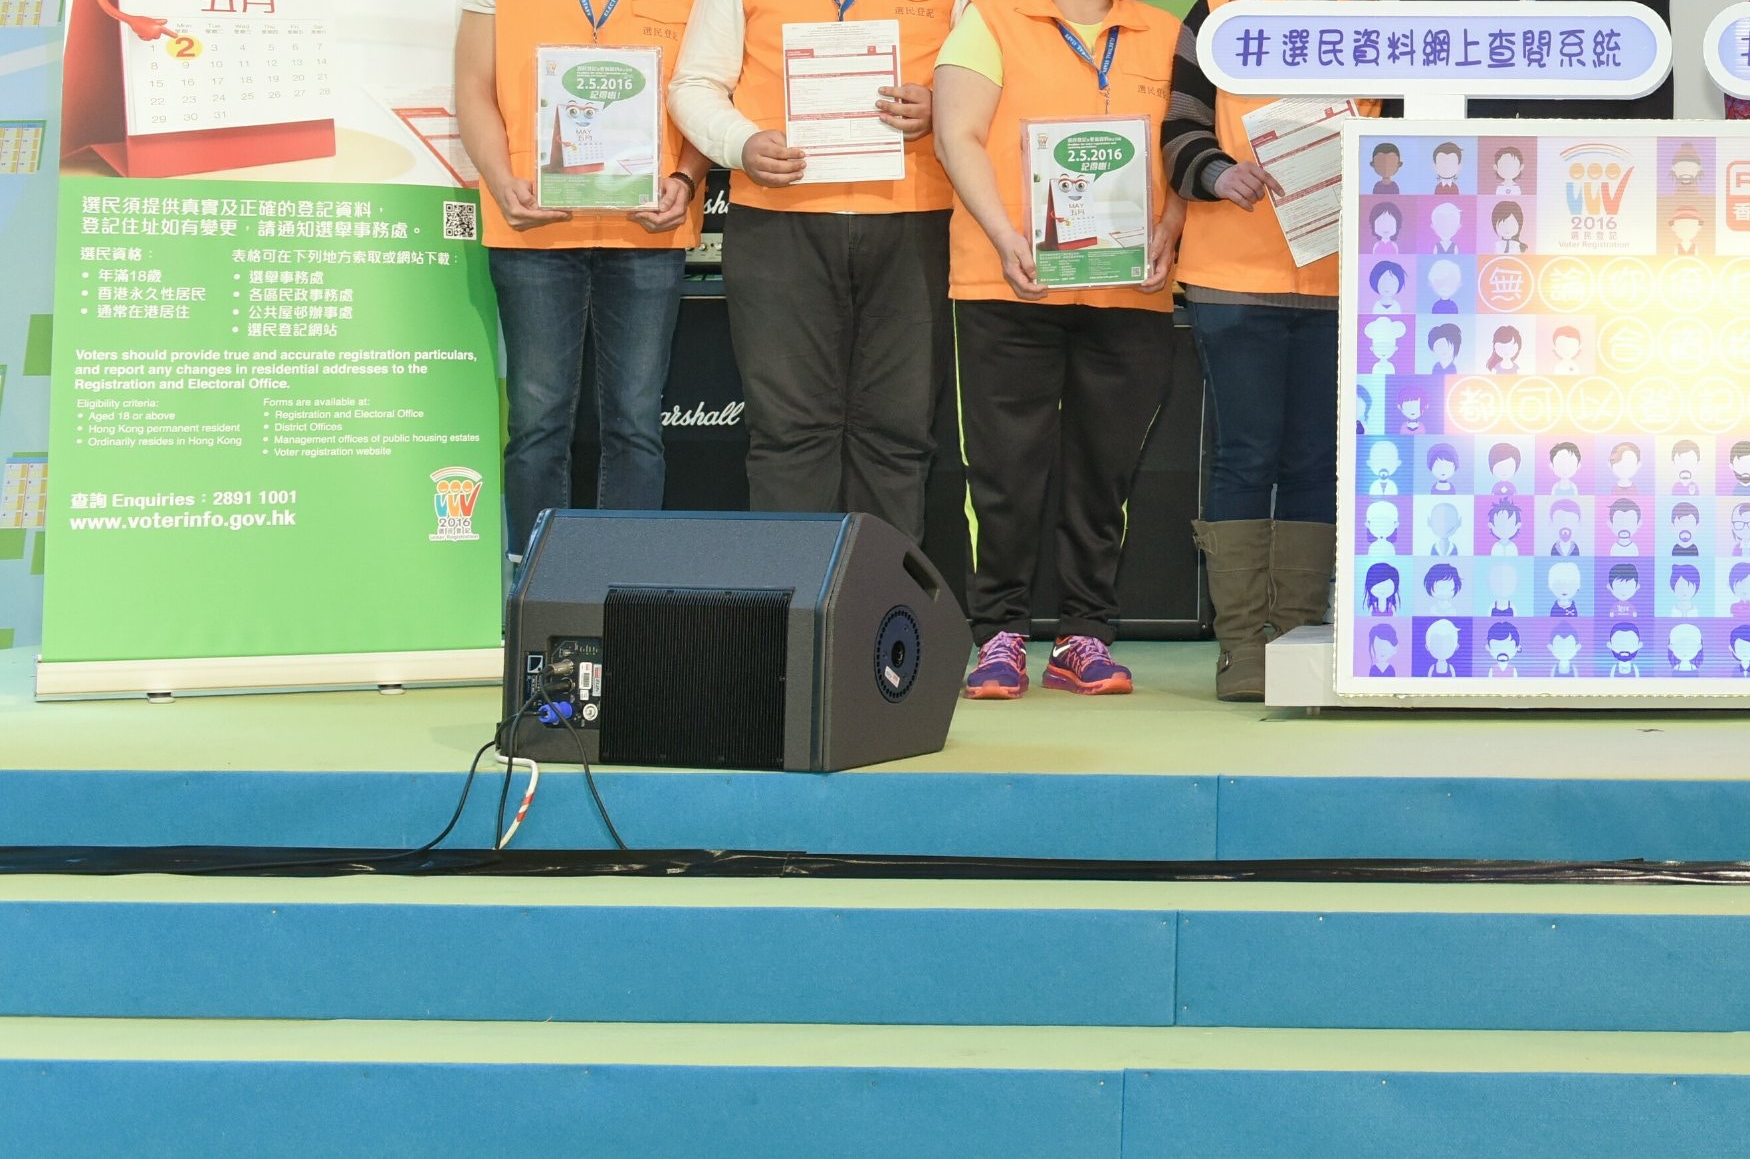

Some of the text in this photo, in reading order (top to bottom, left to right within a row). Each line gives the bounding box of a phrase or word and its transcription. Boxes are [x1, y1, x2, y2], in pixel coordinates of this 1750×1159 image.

[175, 37, 196, 58] 2
[577, 78, 632, 89] 2.5.2016
[1068, 149, 1122, 162] 2.5.2016
[1571, 216, 1617, 230] 2016
[248, 270, 324, 285] 選舉事務處
[97, 287, 206, 301] 香港永久性居民
[248, 288, 353, 302] 各區民政事務處
[97, 304, 190, 319] 通常在港居住
[248, 322, 338, 337] 選民登記網站
[75, 349, 476, 363] Voters should provide true and accurate registration particulars,
[74, 363, 428, 377] and report any changes in residential addresses to the
[74, 378, 290, 392] Registration and Electoral Office.
[660, 401, 746, 426] arshall
[213, 491, 252, 506] 2891
[260, 490, 296, 504] 1001
[70, 510, 296, 530] www.voterinfo.gov.hk
[439, 518, 470, 527] 2016
